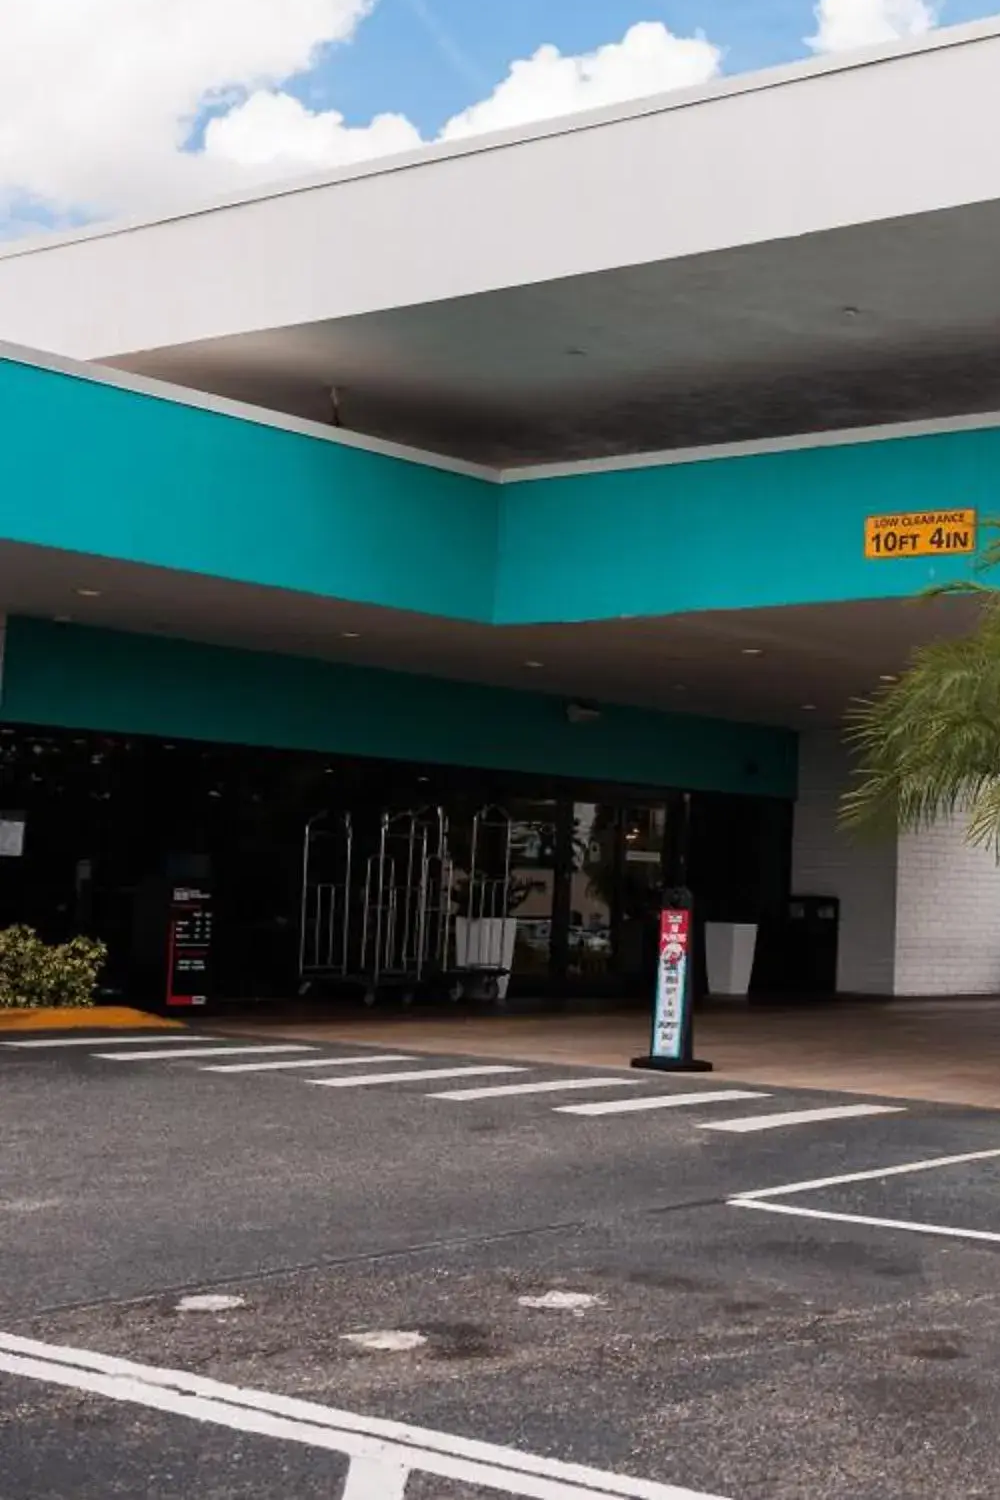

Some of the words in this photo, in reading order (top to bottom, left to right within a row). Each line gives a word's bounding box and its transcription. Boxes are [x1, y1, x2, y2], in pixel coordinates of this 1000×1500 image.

[875, 517, 899, 528] LOW
[901, 513, 964, 527] CLEARANCE
[872, 531, 920, 552] 10FT
[929, 527, 968, 549] 4IN
